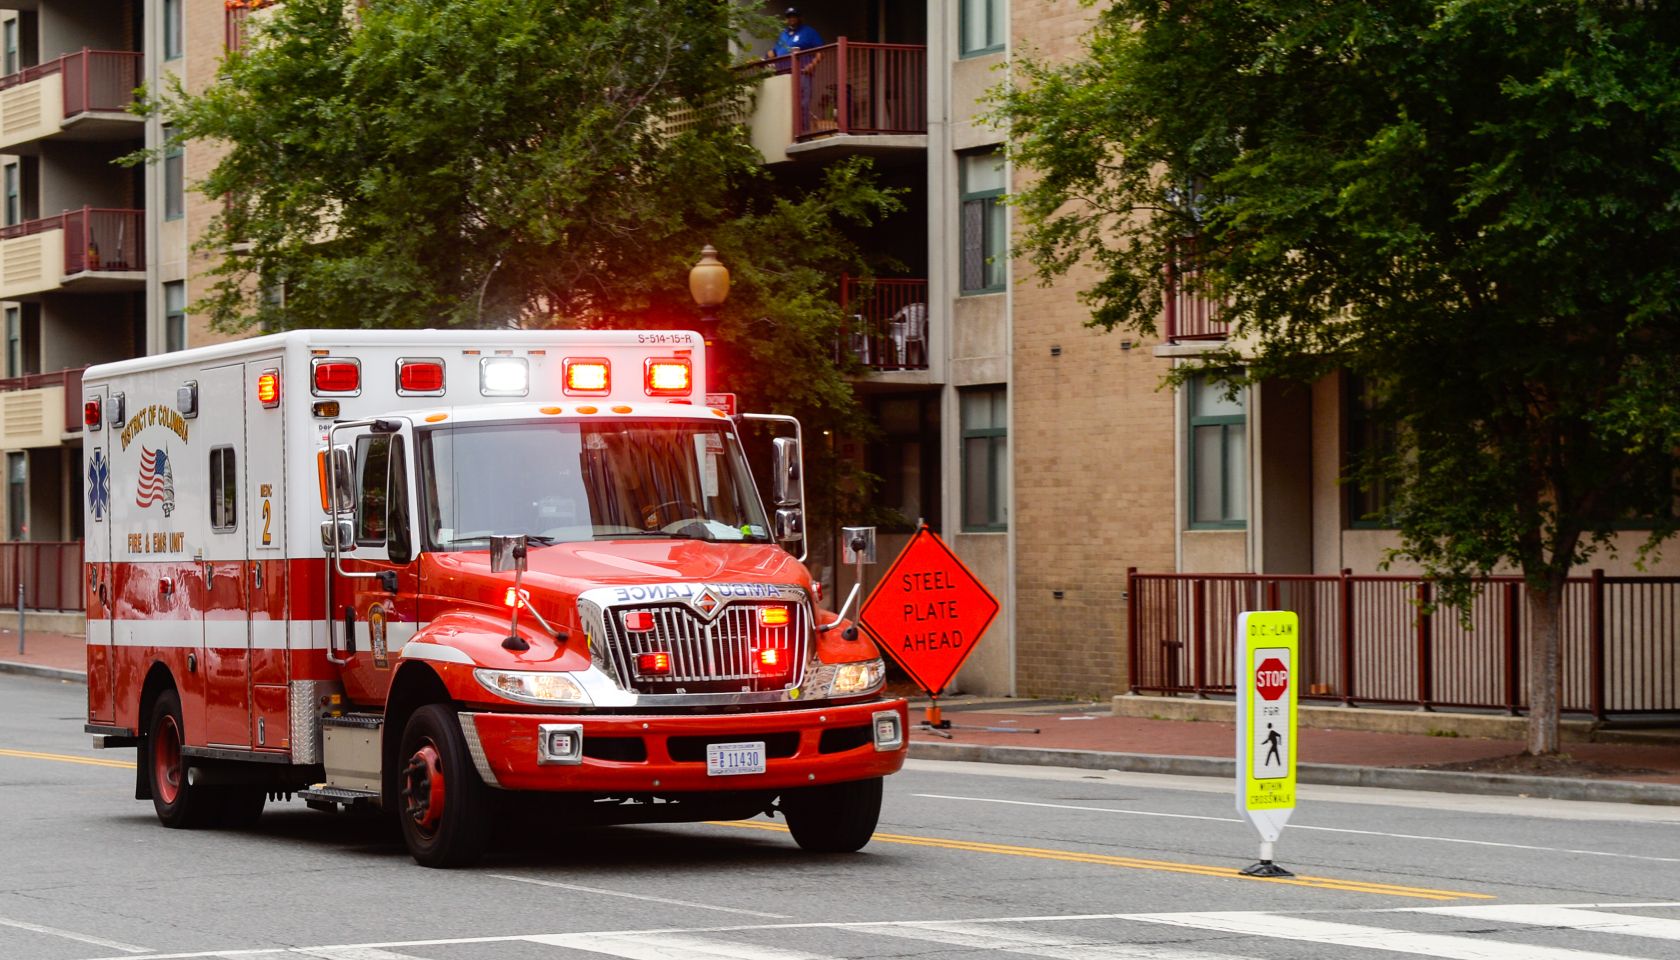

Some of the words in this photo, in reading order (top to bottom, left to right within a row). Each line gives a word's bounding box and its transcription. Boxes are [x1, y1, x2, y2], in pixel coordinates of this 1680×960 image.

[638, 334, 692, 344] S-514-15-R
[121, 407, 147, 452] DISTRICT
[148, 404, 157, 426] OF
[158, 404, 188, 445] COLUMBIA
[262, 499, 272, 546] 2
[127, 532, 142, 554] FIRE
[145, 532, 150, 554] &
[153, 532, 167, 554] EMS
[169, 531, 184, 553] UNIT
[903, 571, 956, 592] STEEL
[903, 600, 959, 621] PLATE
[903, 630, 963, 652] AHEAD
[1257, 670, 1287, 688] STOP
[1264, 706, 1280, 716] FOR
[728, 751, 759, 768] 11430
[1250, 794, 1290, 805] CROSSWALK
